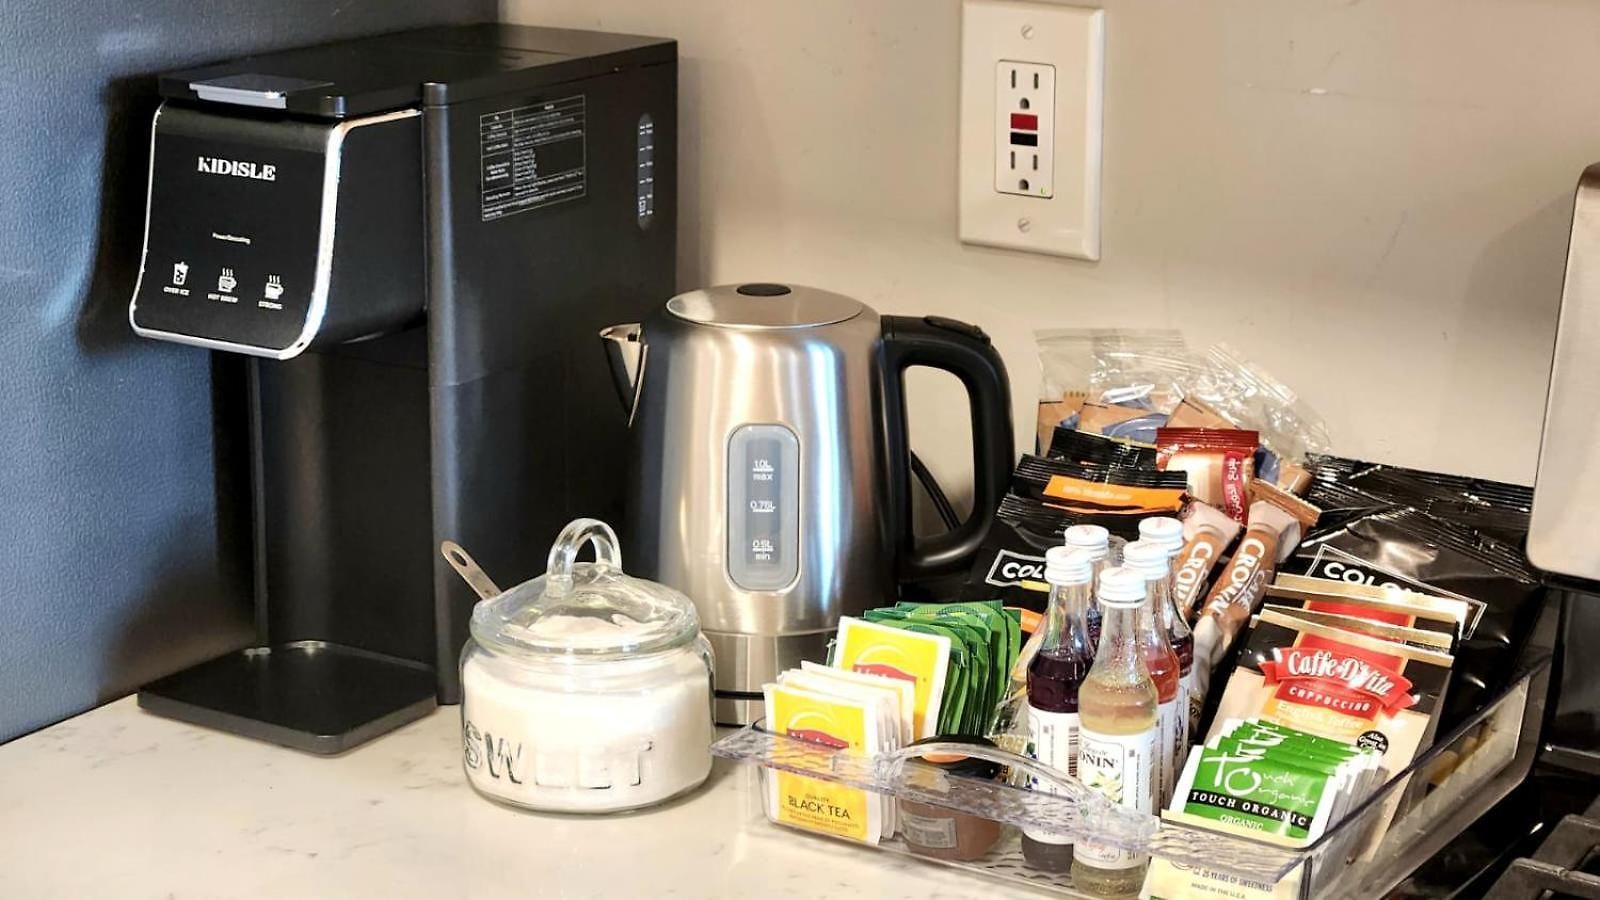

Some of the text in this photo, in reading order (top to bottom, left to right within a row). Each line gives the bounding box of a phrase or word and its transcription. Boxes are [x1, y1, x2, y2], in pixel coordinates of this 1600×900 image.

[197, 156, 276, 181] KIDISLE
[788, 795, 850, 819] BLACK TEA
[1192, 791, 1307, 826] TOUCH ORGANIC
[1220, 814, 1264, 830] ORGANIC
